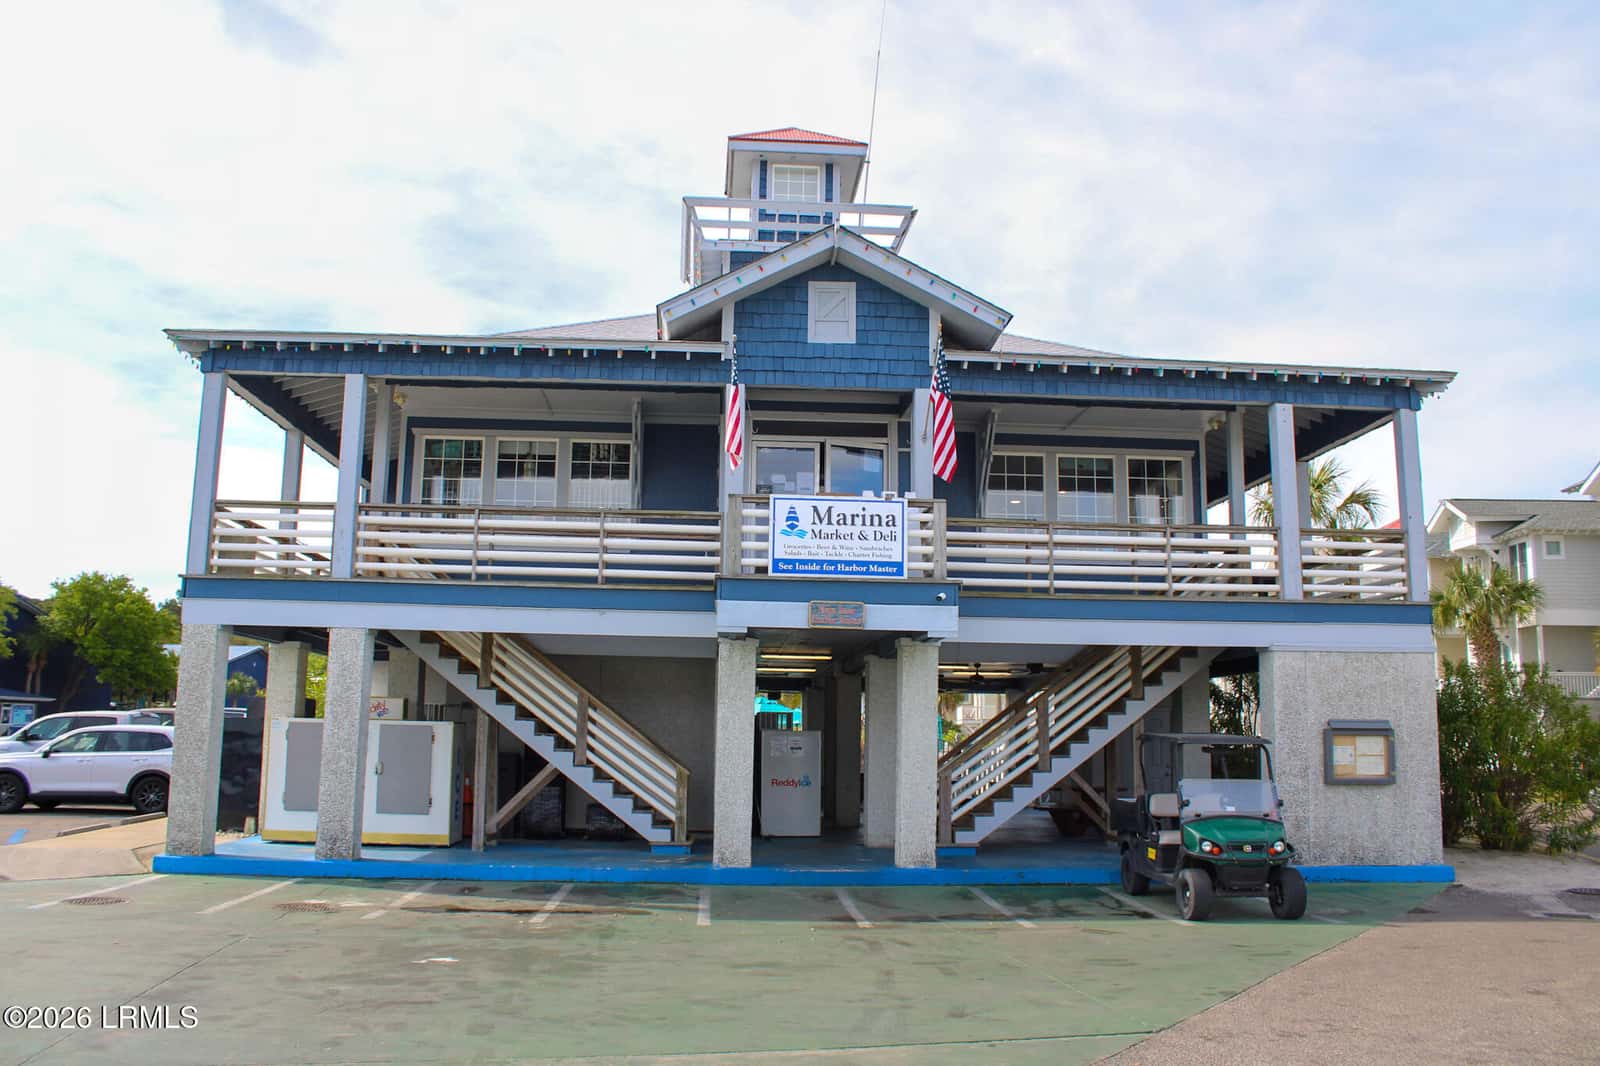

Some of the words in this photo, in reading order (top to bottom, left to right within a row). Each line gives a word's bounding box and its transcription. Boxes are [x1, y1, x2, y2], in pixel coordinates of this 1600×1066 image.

[811, 505, 897, 527] Marina
[811, 529, 854, 541] Market
[857, 530, 869, 541] &
[873, 530, 897, 542] Deli
[778, 562, 793, 570] See
[795, 562, 820, 571] Inside
[823, 562, 835, 571] for
[837, 562, 868, 572] Harbor
[869, 564, 897, 573] Master
